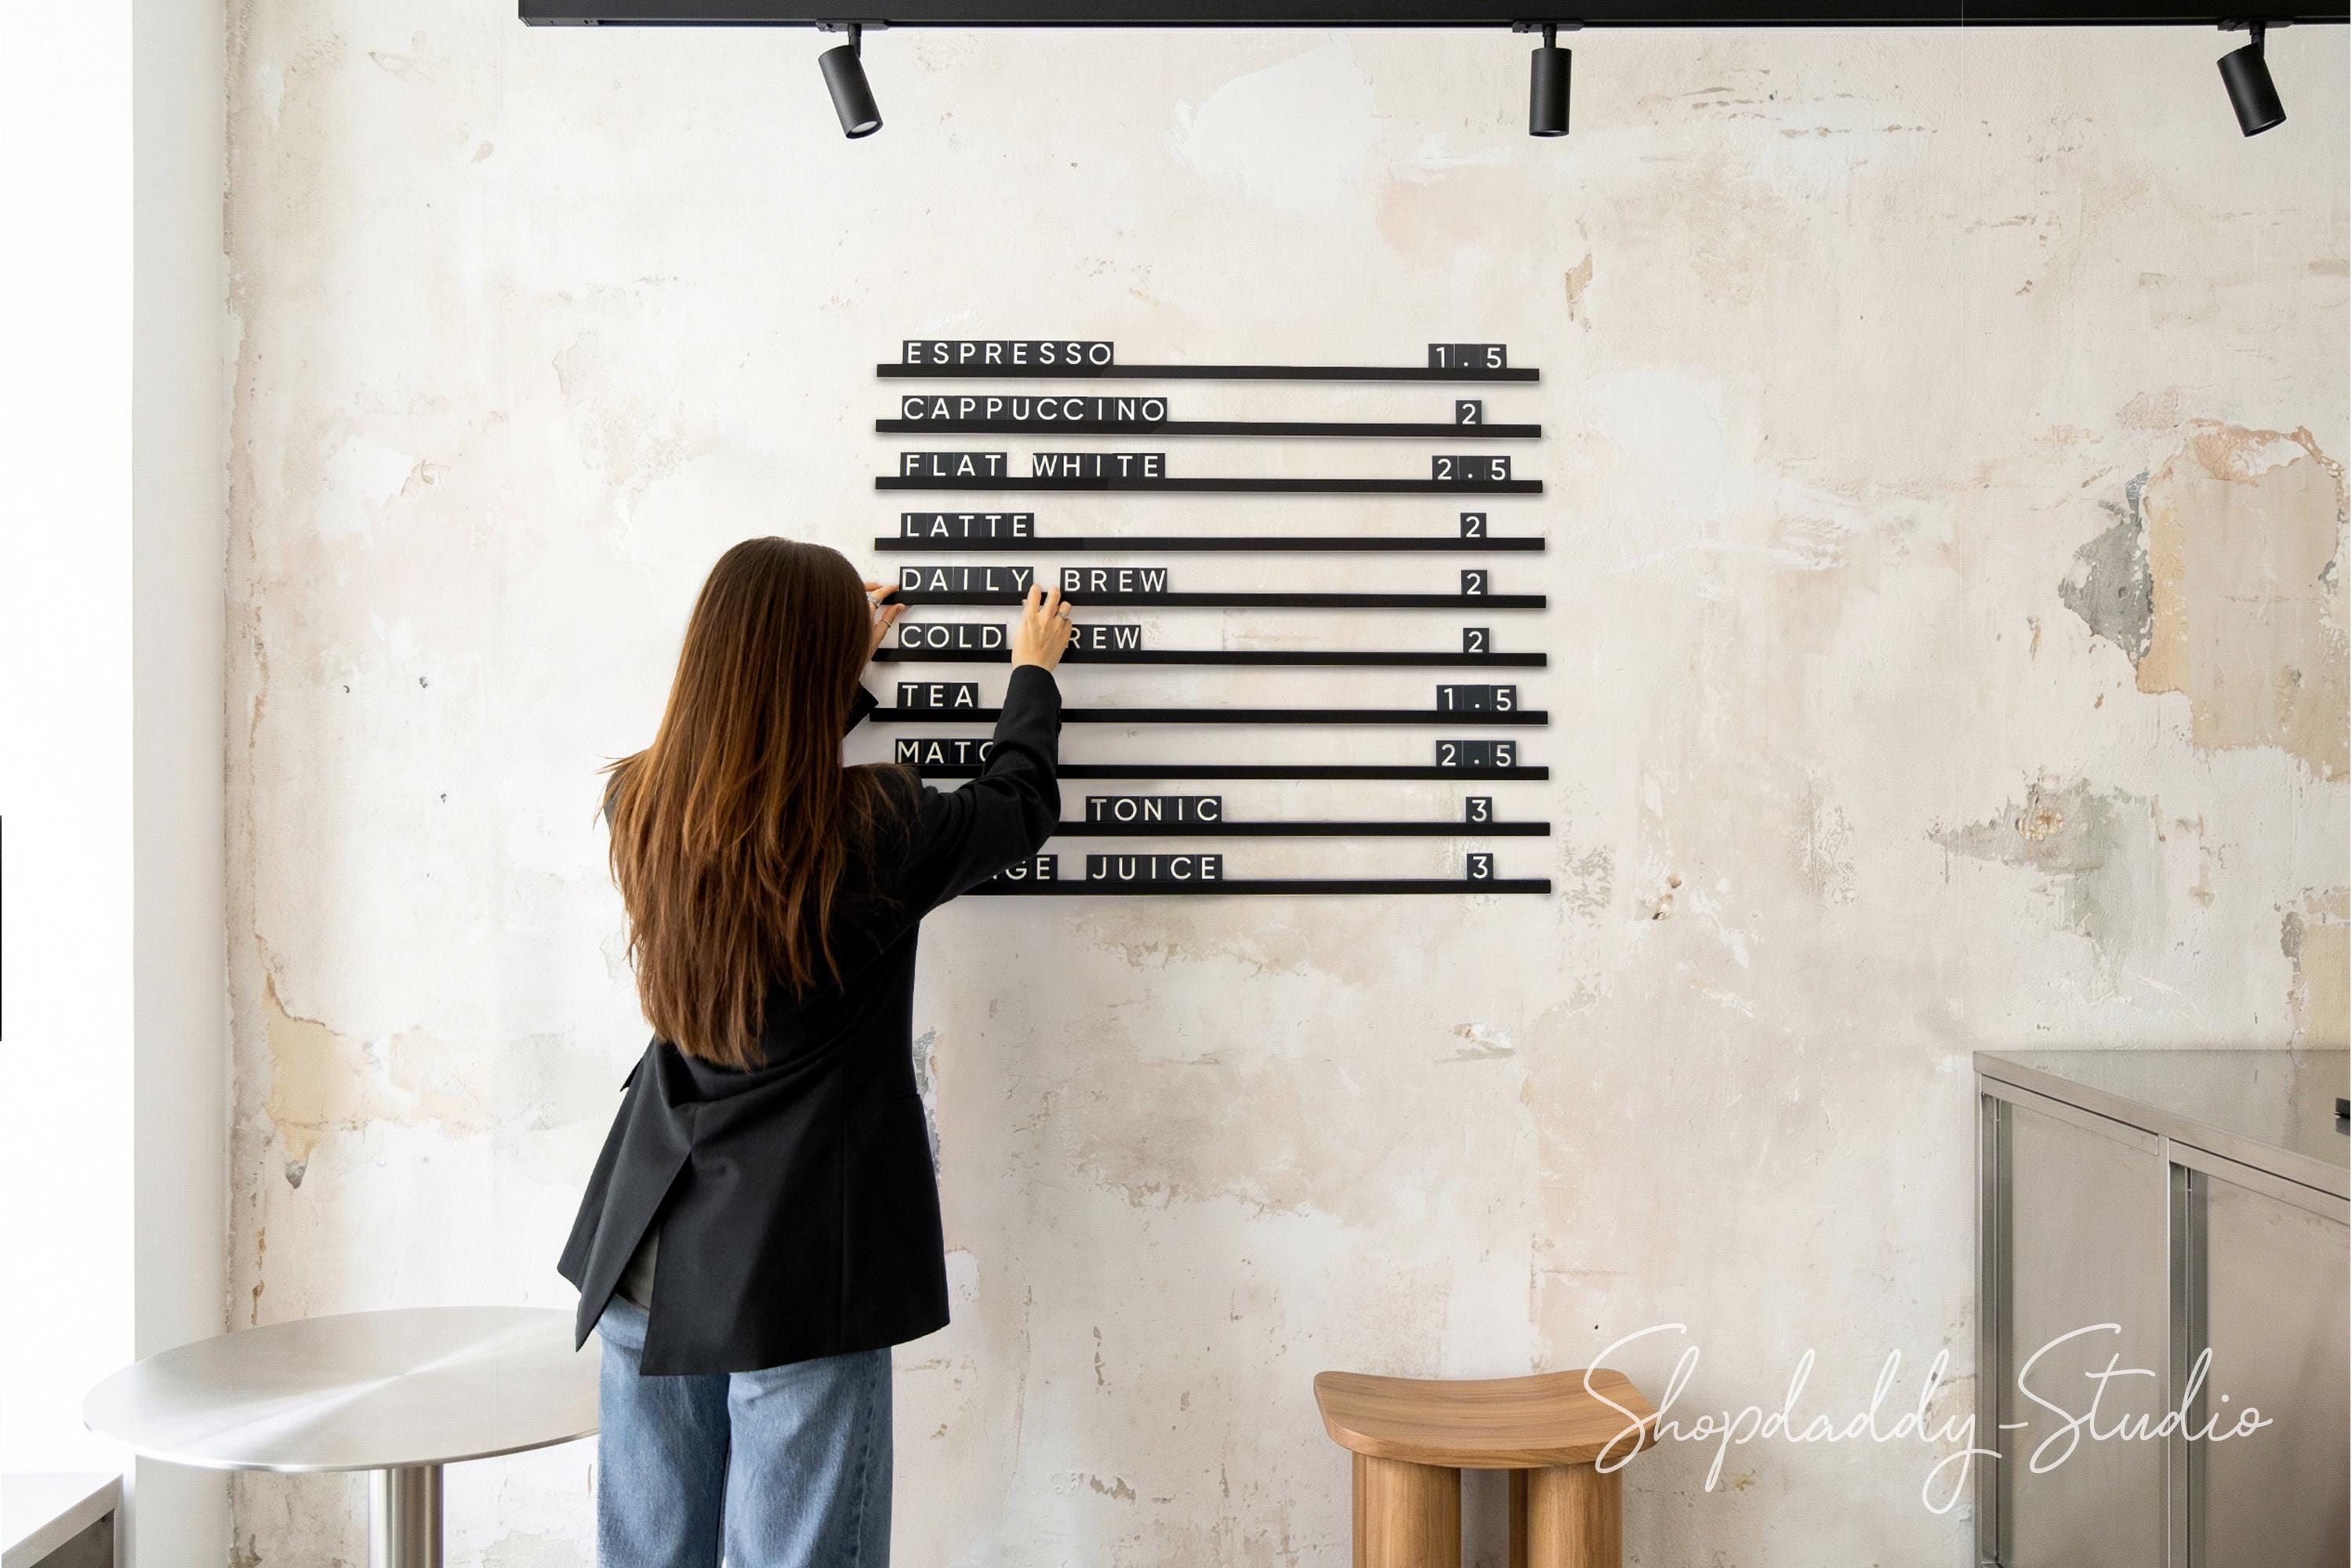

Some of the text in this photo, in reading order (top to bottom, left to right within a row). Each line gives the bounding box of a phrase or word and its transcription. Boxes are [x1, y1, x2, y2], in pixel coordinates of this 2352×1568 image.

[907, 342, 1502, 368] ESPRESSO 1.5
[903, 397, 1476, 425] CAPPUCCINO 2
[906, 454, 1506, 481] FLAT WHITE 2.5
[906, 514, 1481, 538] LATTE 2
[902, 568, 1482, 595] DAILY BREW 2
[901, 625, 1483, 653] COLD REW 2
[902, 684, 1512, 711] TEA 1.5
[1441, 743, 1512, 768] 2.5
[1091, 798, 1487, 822] TONIC 3
[1092, 856, 1215, 880] JUICE
[1472, 855, 1488, 880] 3
